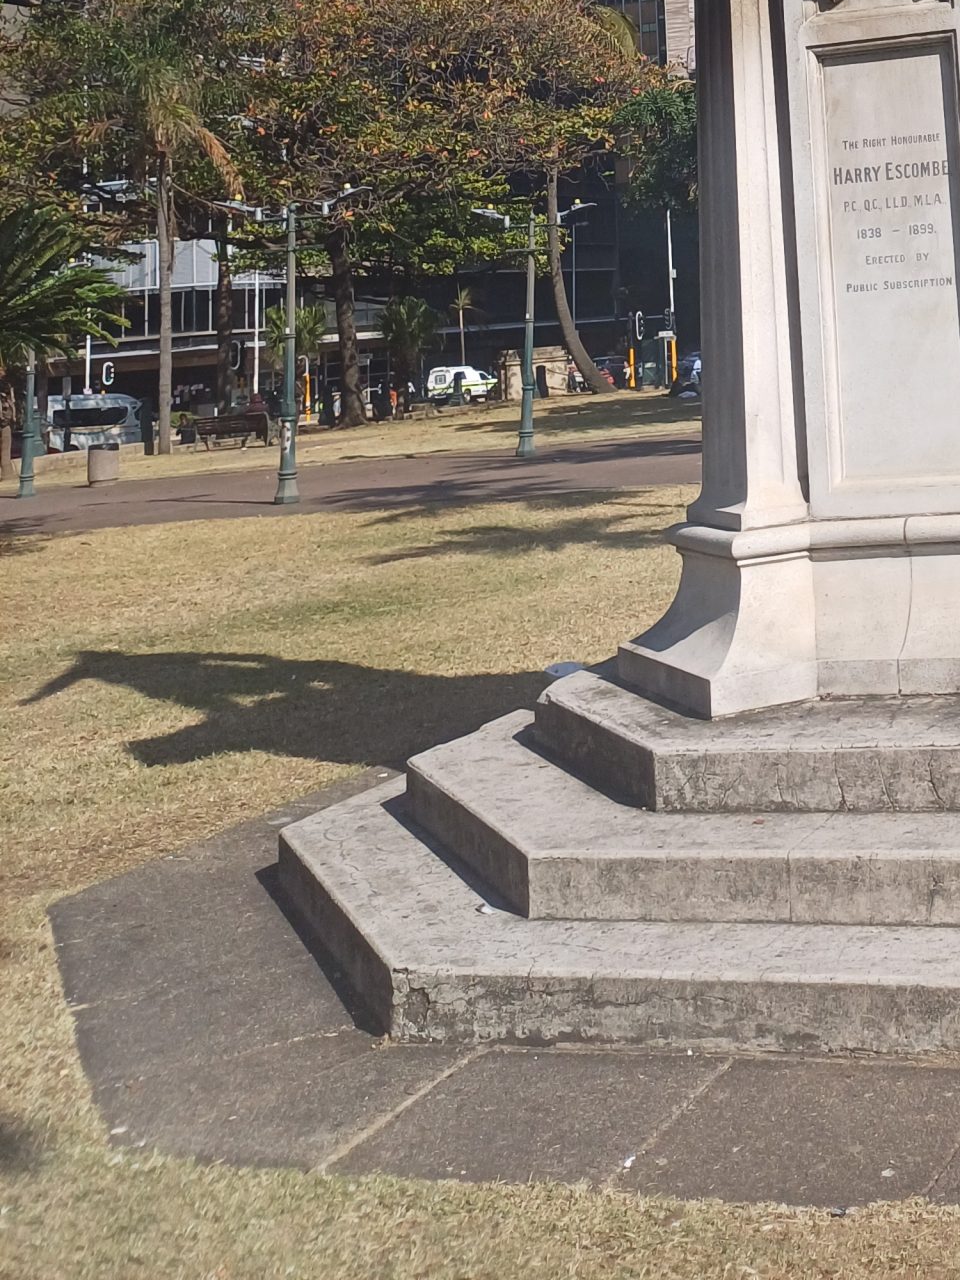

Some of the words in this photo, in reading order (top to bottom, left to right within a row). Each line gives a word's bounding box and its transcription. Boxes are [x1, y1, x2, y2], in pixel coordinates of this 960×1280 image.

[842, 140, 860, 151] THE
[862, 138, 887, 149] RIGHT
[890, 133, 941, 146] HONOURABLE
[833, 166, 881, 186] HARRY
[884, 159, 951, 181] ESCOMBE
[856, 227, 882, 240] 1838
[865, 254, 906, 266] ERECTED
[915, 252, 929, 262] BY
[846, 283, 878, 294] PUBLIC
[883, 277, 953, 291] SUBSCRIPTION
